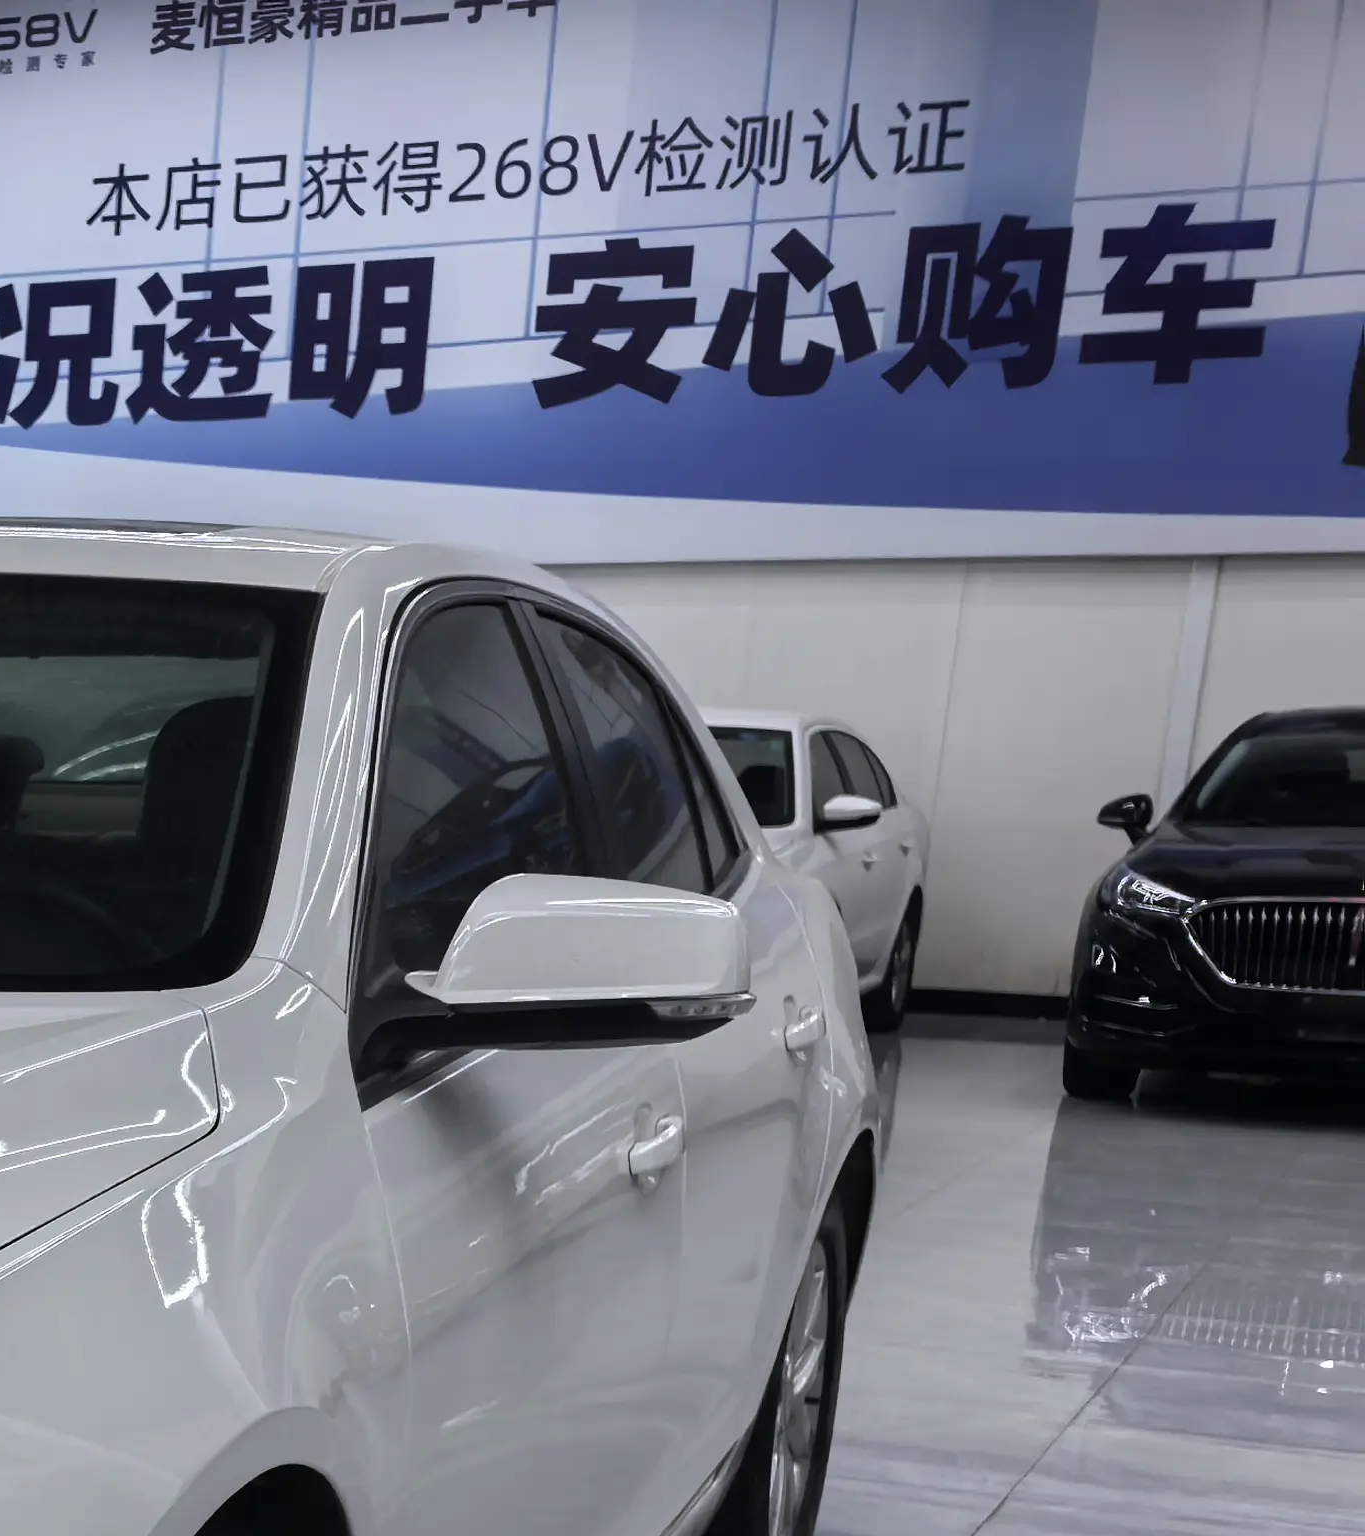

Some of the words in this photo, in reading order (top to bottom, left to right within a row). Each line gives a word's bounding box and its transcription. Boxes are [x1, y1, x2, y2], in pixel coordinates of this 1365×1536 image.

[85, 98, 971, 237] 本店已获得268V检测认证
[531, 202, 1277, 410] 安心购车
